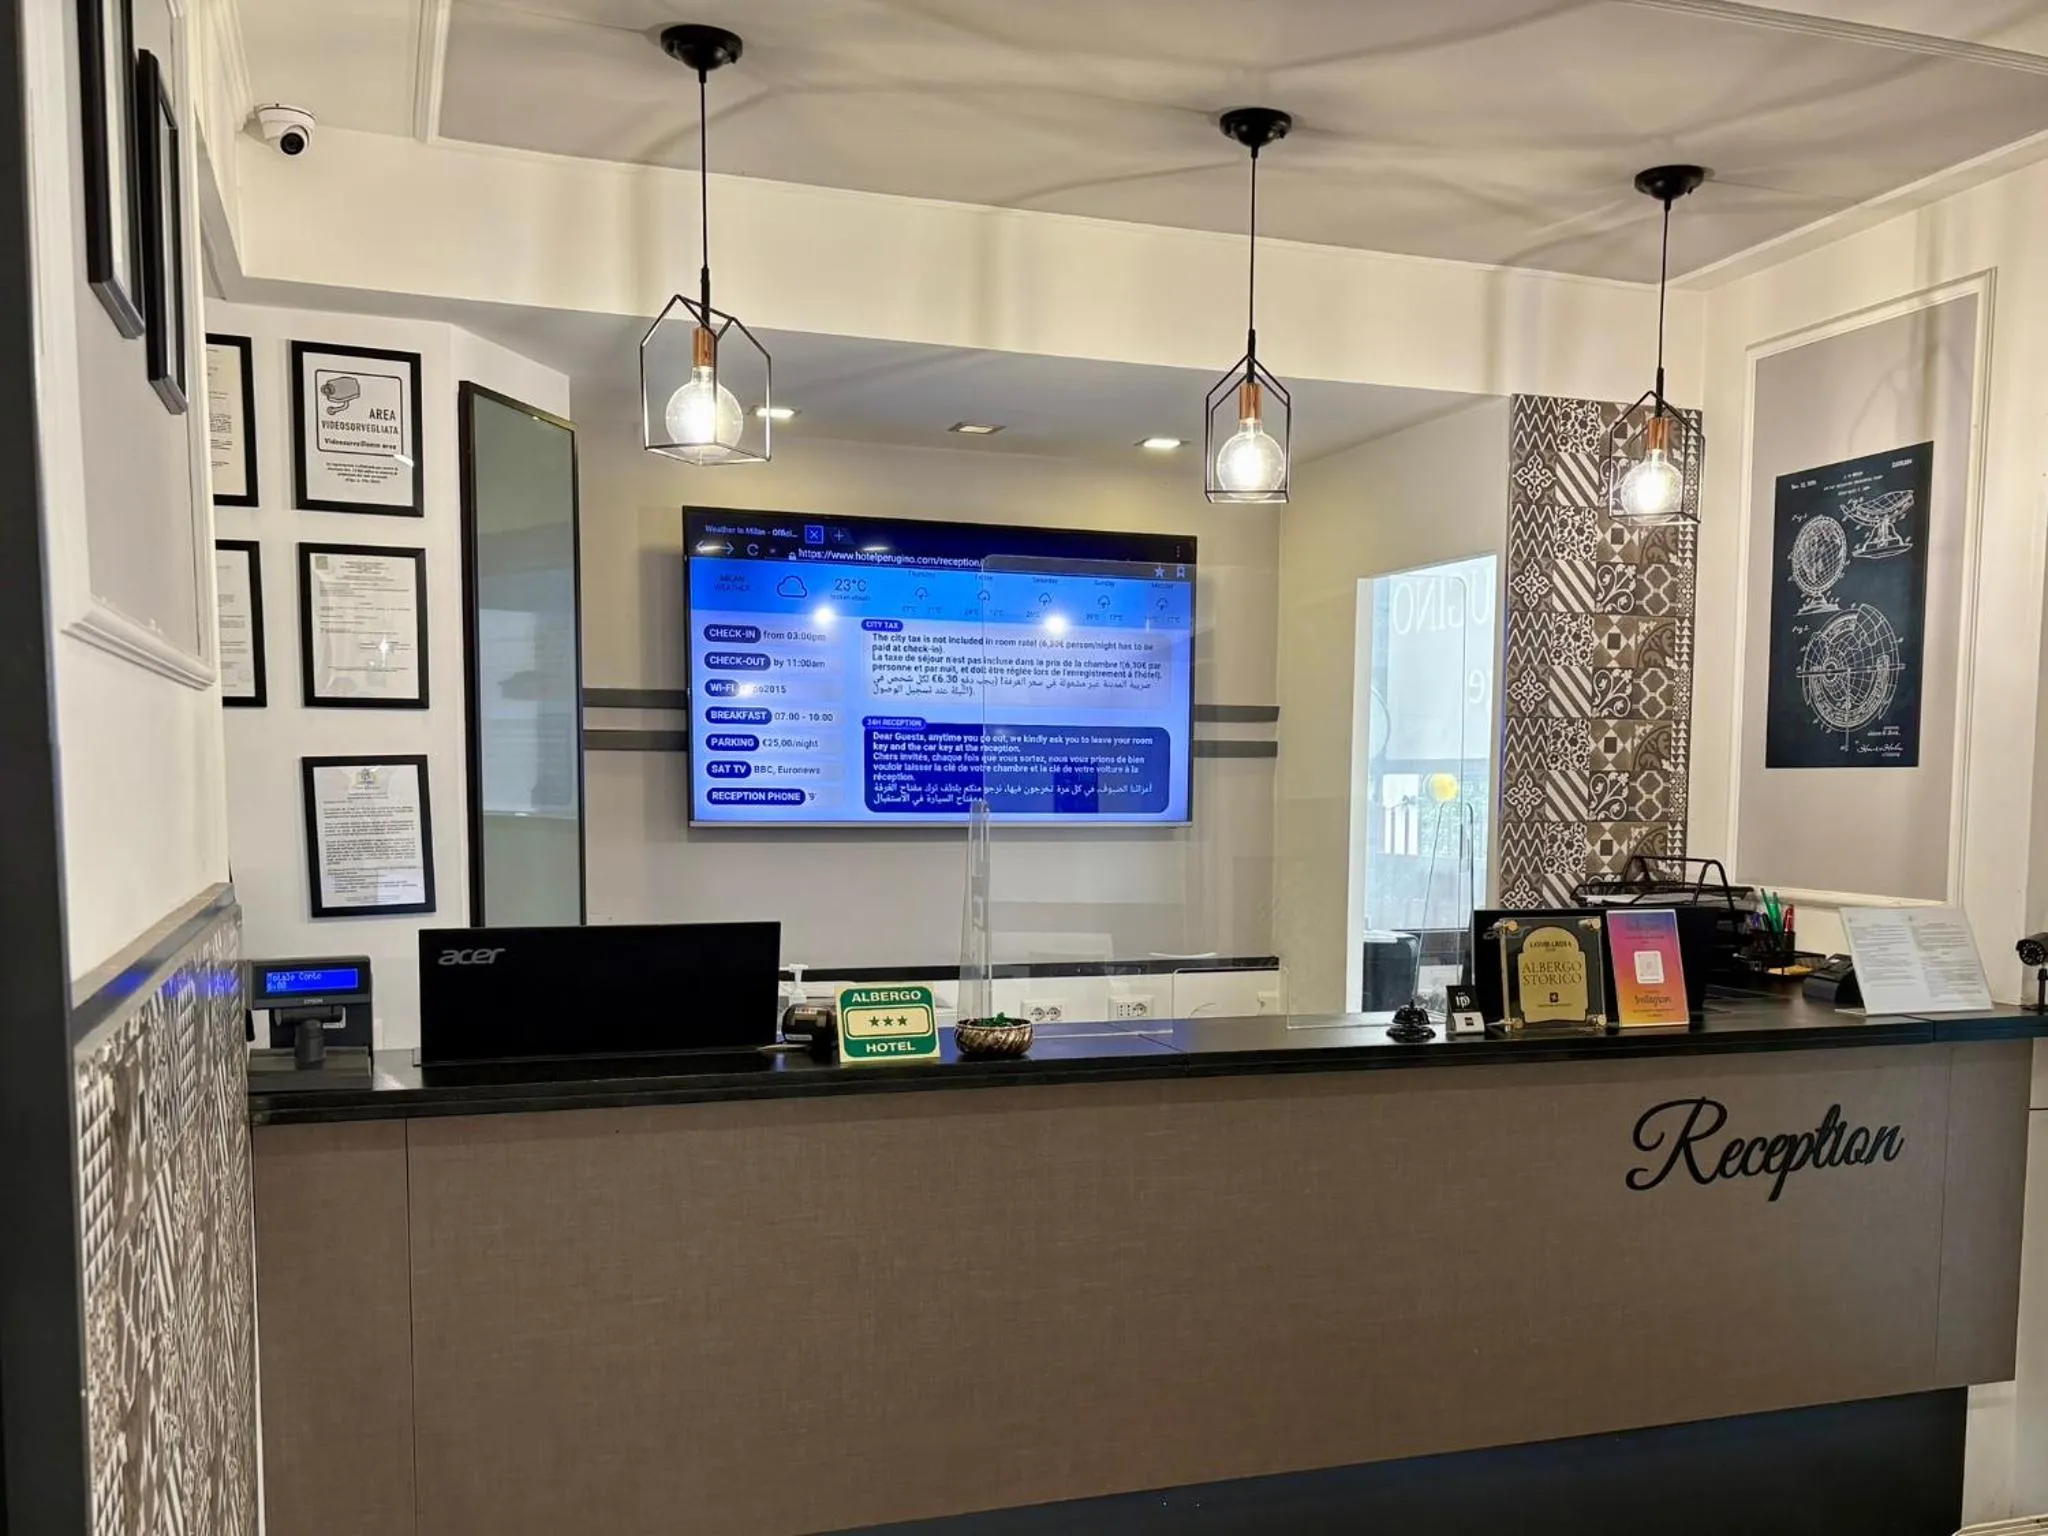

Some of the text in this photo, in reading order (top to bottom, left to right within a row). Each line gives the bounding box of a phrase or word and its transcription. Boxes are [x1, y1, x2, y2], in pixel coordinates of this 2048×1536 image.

[369, 408, 396, 421] AREA
[834, 579, 867, 592] 23°C
[709, 629, 756, 638] CHECK-IN
[763, 631, 785, 640] from
[873, 633, 888, 641] The
[891, 634, 906, 643] city
[949, 636, 983, 645] included
[872, 644, 890, 652] paid
[893, 644, 901, 652] at
[710, 656, 765, 666] CHECK-OUT
[773, 658, 784, 668] by
[1083, 660, 1118, 668] chambre
[872, 664, 912, 672] personne
[710, 683, 734, 693] WI-FI
[710, 711, 834, 721] BREAKFAST 07:00 10:00
[711, 738, 755, 747] PARKING
[873, 732, 893, 740] Dear
[895, 732, 927, 742] Guests,
[928, 734, 962, 743] anytime
[963, 735, 979, 743] you
[1024, 735, 1047, 745] kindly
[1065, 737, 1079, 745] you
[1091, 736, 1112, 744] leave
[1114, 737, 1130, 745] your
[873, 742, 888, 751] key
[939, 744, 953, 752] key
[873, 752, 898, 760] Chers
[900, 753, 930, 762] invités,
[932, 753, 962, 762] chaque
[964, 753, 979, 761] fois
[1128, 755, 1144, 763] bien
[711, 765, 731, 773] SAT
[733, 765, 747, 773] TV
[778, 766, 820, 774] Euronews
[873, 763, 902, 771] vouloir
[904, 763, 932, 771] laisser
[958, 764, 968, 772] de
[993, 764, 1028, 772] chambre
[1049, 765, 1060, 773] clé
[1062, 765, 1072, 773] de
[712, 791, 766, 800] RECEPTION
[767, 792, 801, 801] PHONE
[438, 948, 506, 965] acer
[1522, 960, 1582, 974] ALBERGO
[1523, 972, 1582, 986] STORICO
[852, 990, 921, 1003] ALBERGO
[866, 1041, 916, 1053] HOTEL
[1625, 1096, 1905, 1202] Reception
